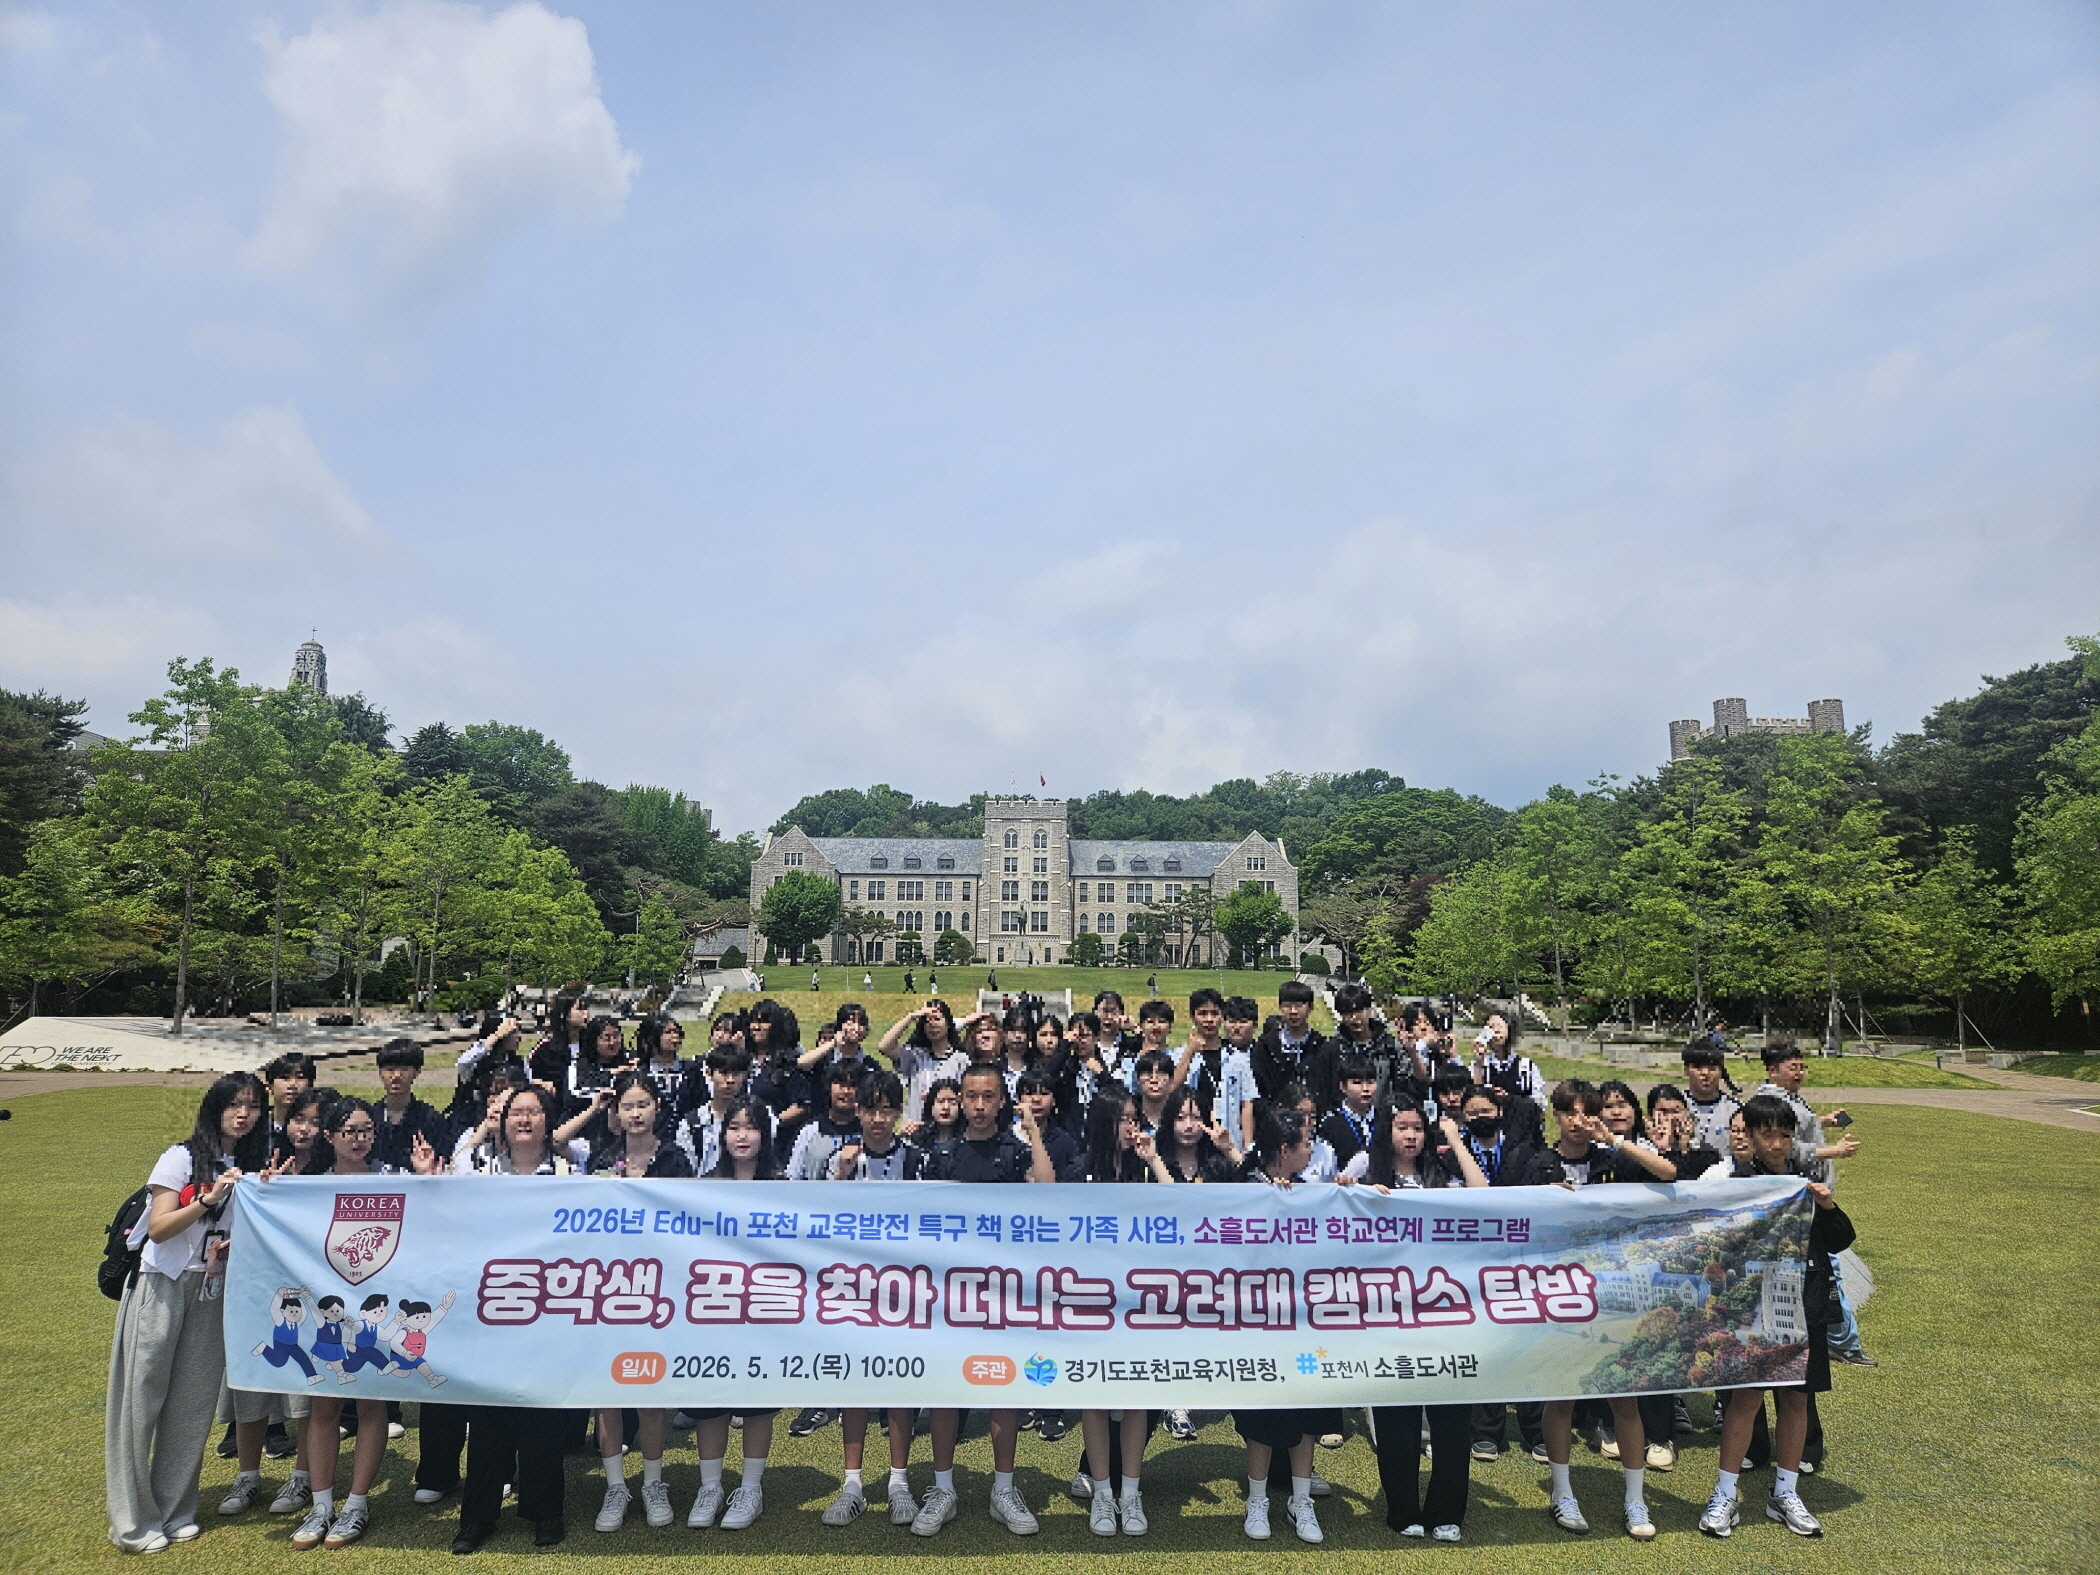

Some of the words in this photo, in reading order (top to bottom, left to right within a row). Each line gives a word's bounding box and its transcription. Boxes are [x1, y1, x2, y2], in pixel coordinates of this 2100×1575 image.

[340, 1197, 400, 1209] KOREA
[552, 1207, 646, 1234] 2026년
[653, 1210, 738, 1237] Edu-In
[746, 1212, 798, 1239] 포천
[806, 1212, 909, 1241] 교육발전
[918, 1214, 967, 1242] 특구
[976, 1214, 1001, 1242] 책
[1010, 1215, 1060, 1243] 읽는
[1069, 1215, 1119, 1244] 가족
[1127, 1216, 1185, 1245] 사업,
[1193, 1216, 1318, 1244] 소흘도서관
[1325, 1216, 1423, 1244] 학교연계
[1431, 1217, 1531, 1243] 프로그램
[477, 1258, 675, 1329] 중학생,
[686, 1259, 807, 1325] 꿈을
[816, 1262, 938, 1330] 찾아
[945, 1266, 1117, 1331] 떠나는
[1124, 1268, 1297, 1331] 고려대
[1304, 1266, 1476, 1331] 캠퍼스
[1479, 1263, 1598, 1325] 탐방
[621, 1358, 657, 1378] 일시
[672, 1355, 736, 1379] 2026.
[747, 1356, 769, 1379] 5.
[779, 1353, 851, 1380] 12.(목)
[861, 1357, 925, 1378] 10:00
[971, 1360, 1007, 1379] 주관
[1064, 1358, 1286, 1382] 경기도포천교육지원청,
[1320, 1360, 1370, 1379] 포천시
[1374, 1354, 1479, 1379] 소흘도서관
